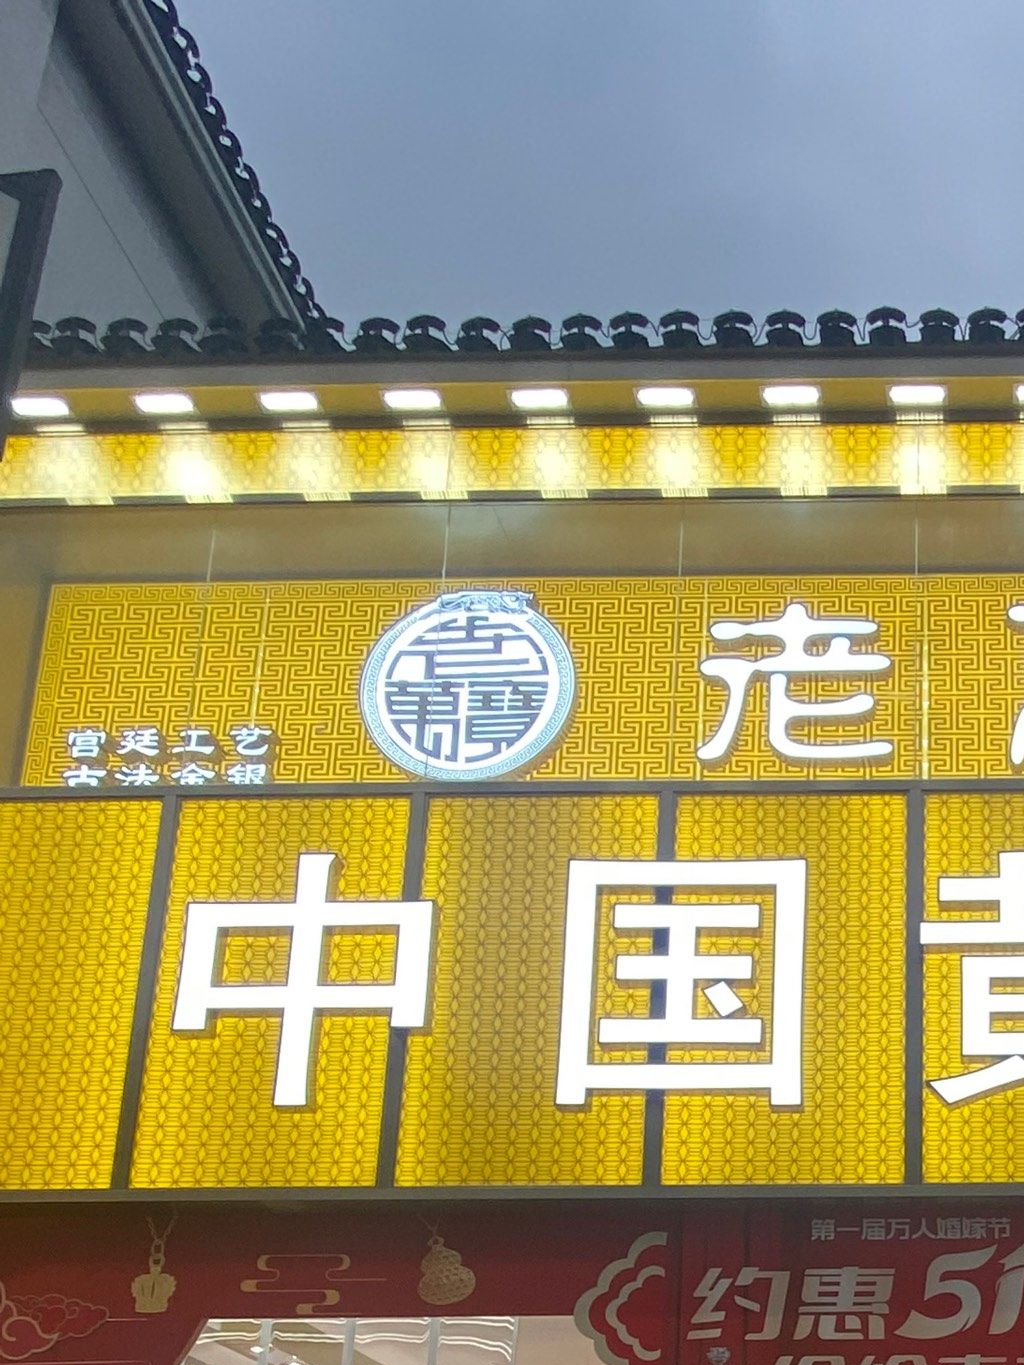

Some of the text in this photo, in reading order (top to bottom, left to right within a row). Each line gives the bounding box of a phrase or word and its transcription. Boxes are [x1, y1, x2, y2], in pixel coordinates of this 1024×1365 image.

[67, 727, 273, 759] 宫廷工艺
[811, 1217, 1012, 1241] 第一届万人婚嫁节
